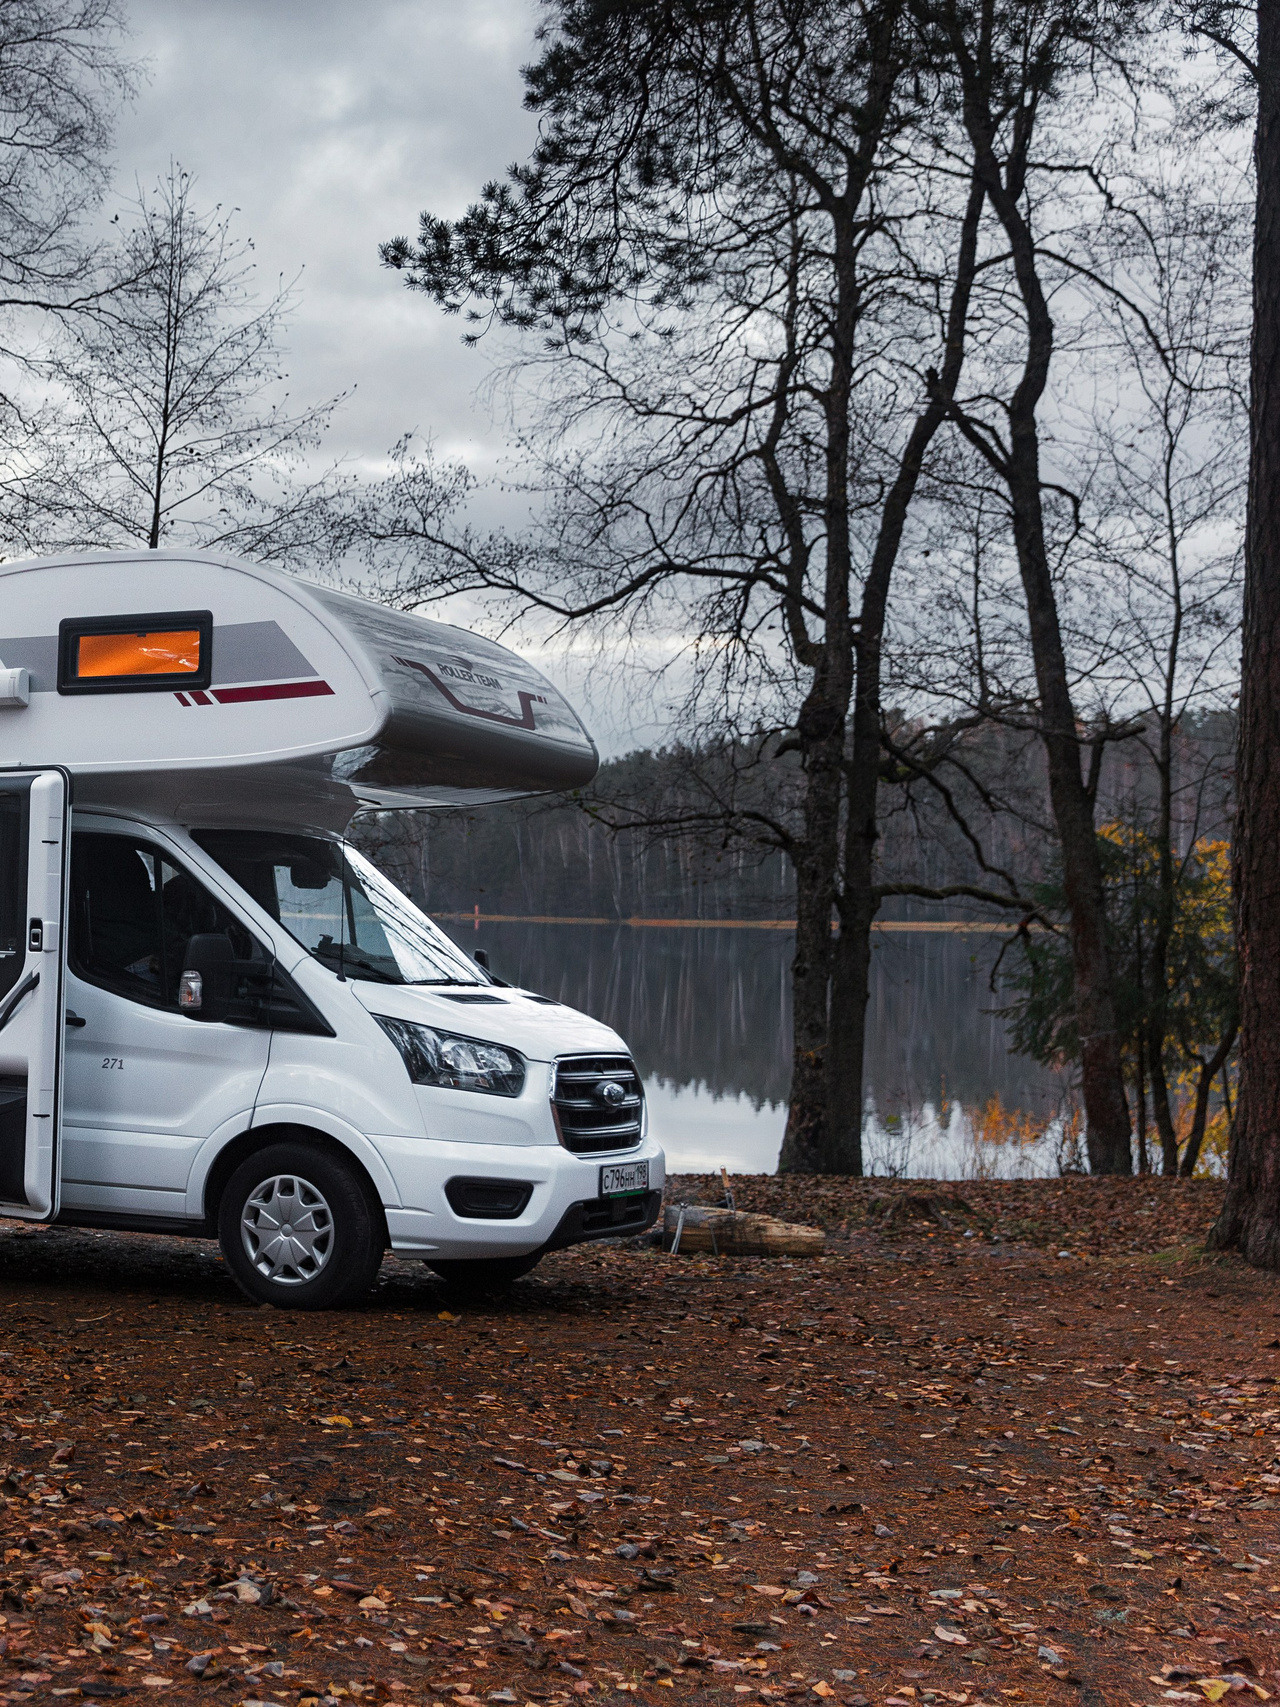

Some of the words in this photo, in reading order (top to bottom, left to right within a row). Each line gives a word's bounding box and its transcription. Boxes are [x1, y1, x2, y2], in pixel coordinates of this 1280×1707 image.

[436, 662, 477, 684] ROLLER
[474, 673, 504, 690] TEAM
[101, 1057, 124, 1070] 271
